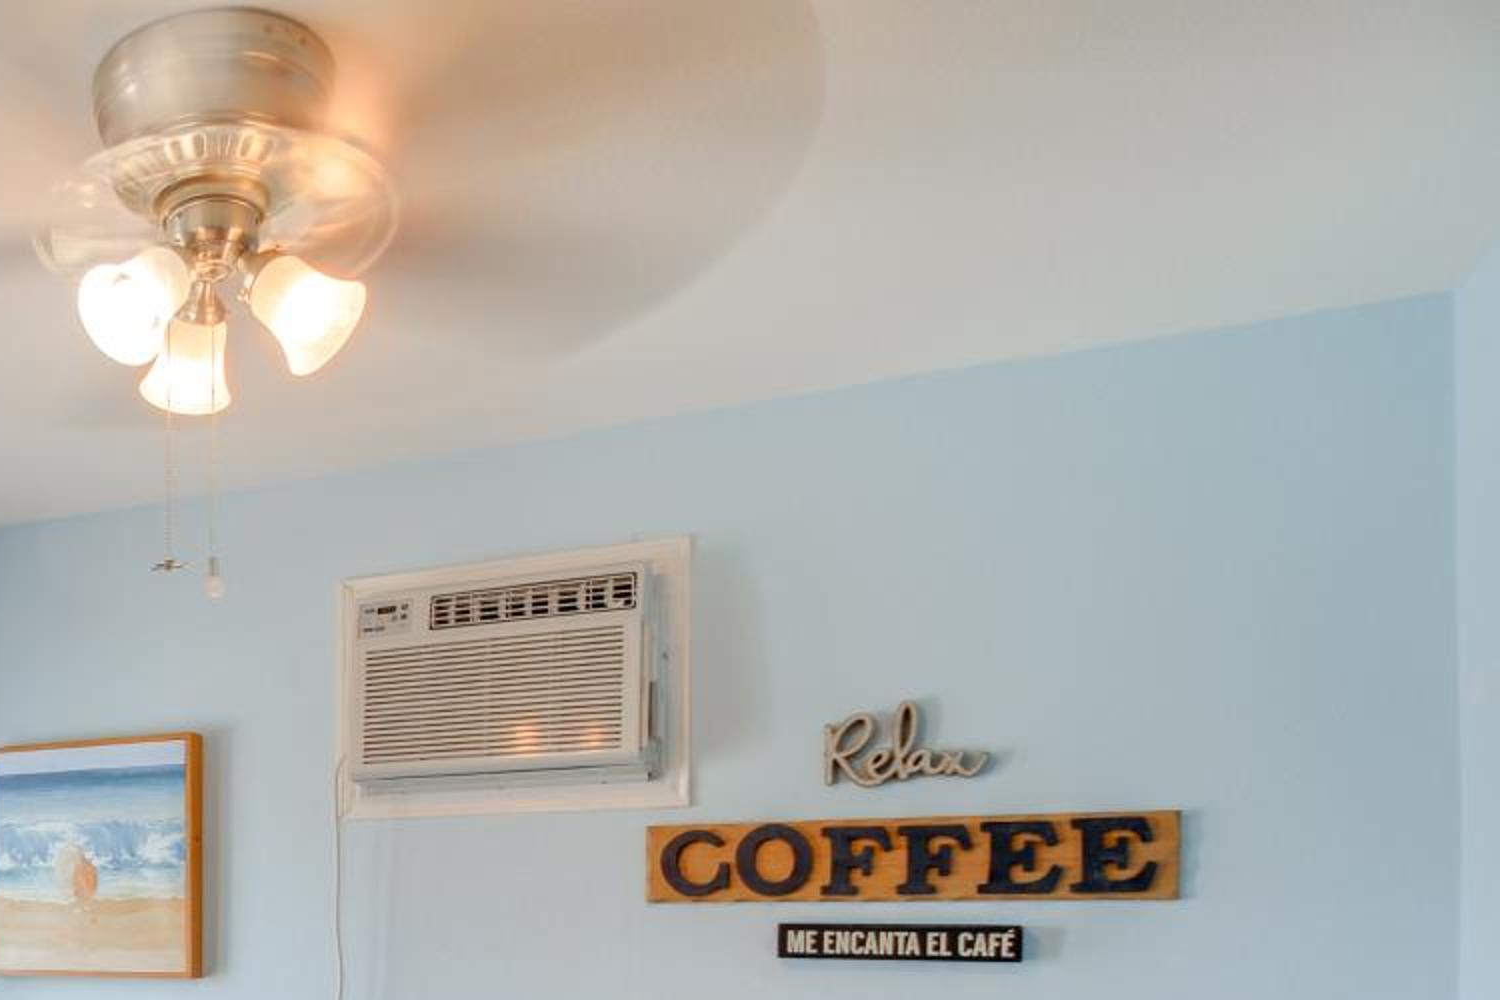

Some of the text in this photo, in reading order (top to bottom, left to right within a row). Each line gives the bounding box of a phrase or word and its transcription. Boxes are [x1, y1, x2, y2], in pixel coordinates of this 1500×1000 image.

[822, 702, 989, 787] Relax
[660, 817, 1159, 897] COFFEE
[787, 928, 1016, 958] ME ENCANTA EL CAFÉ
